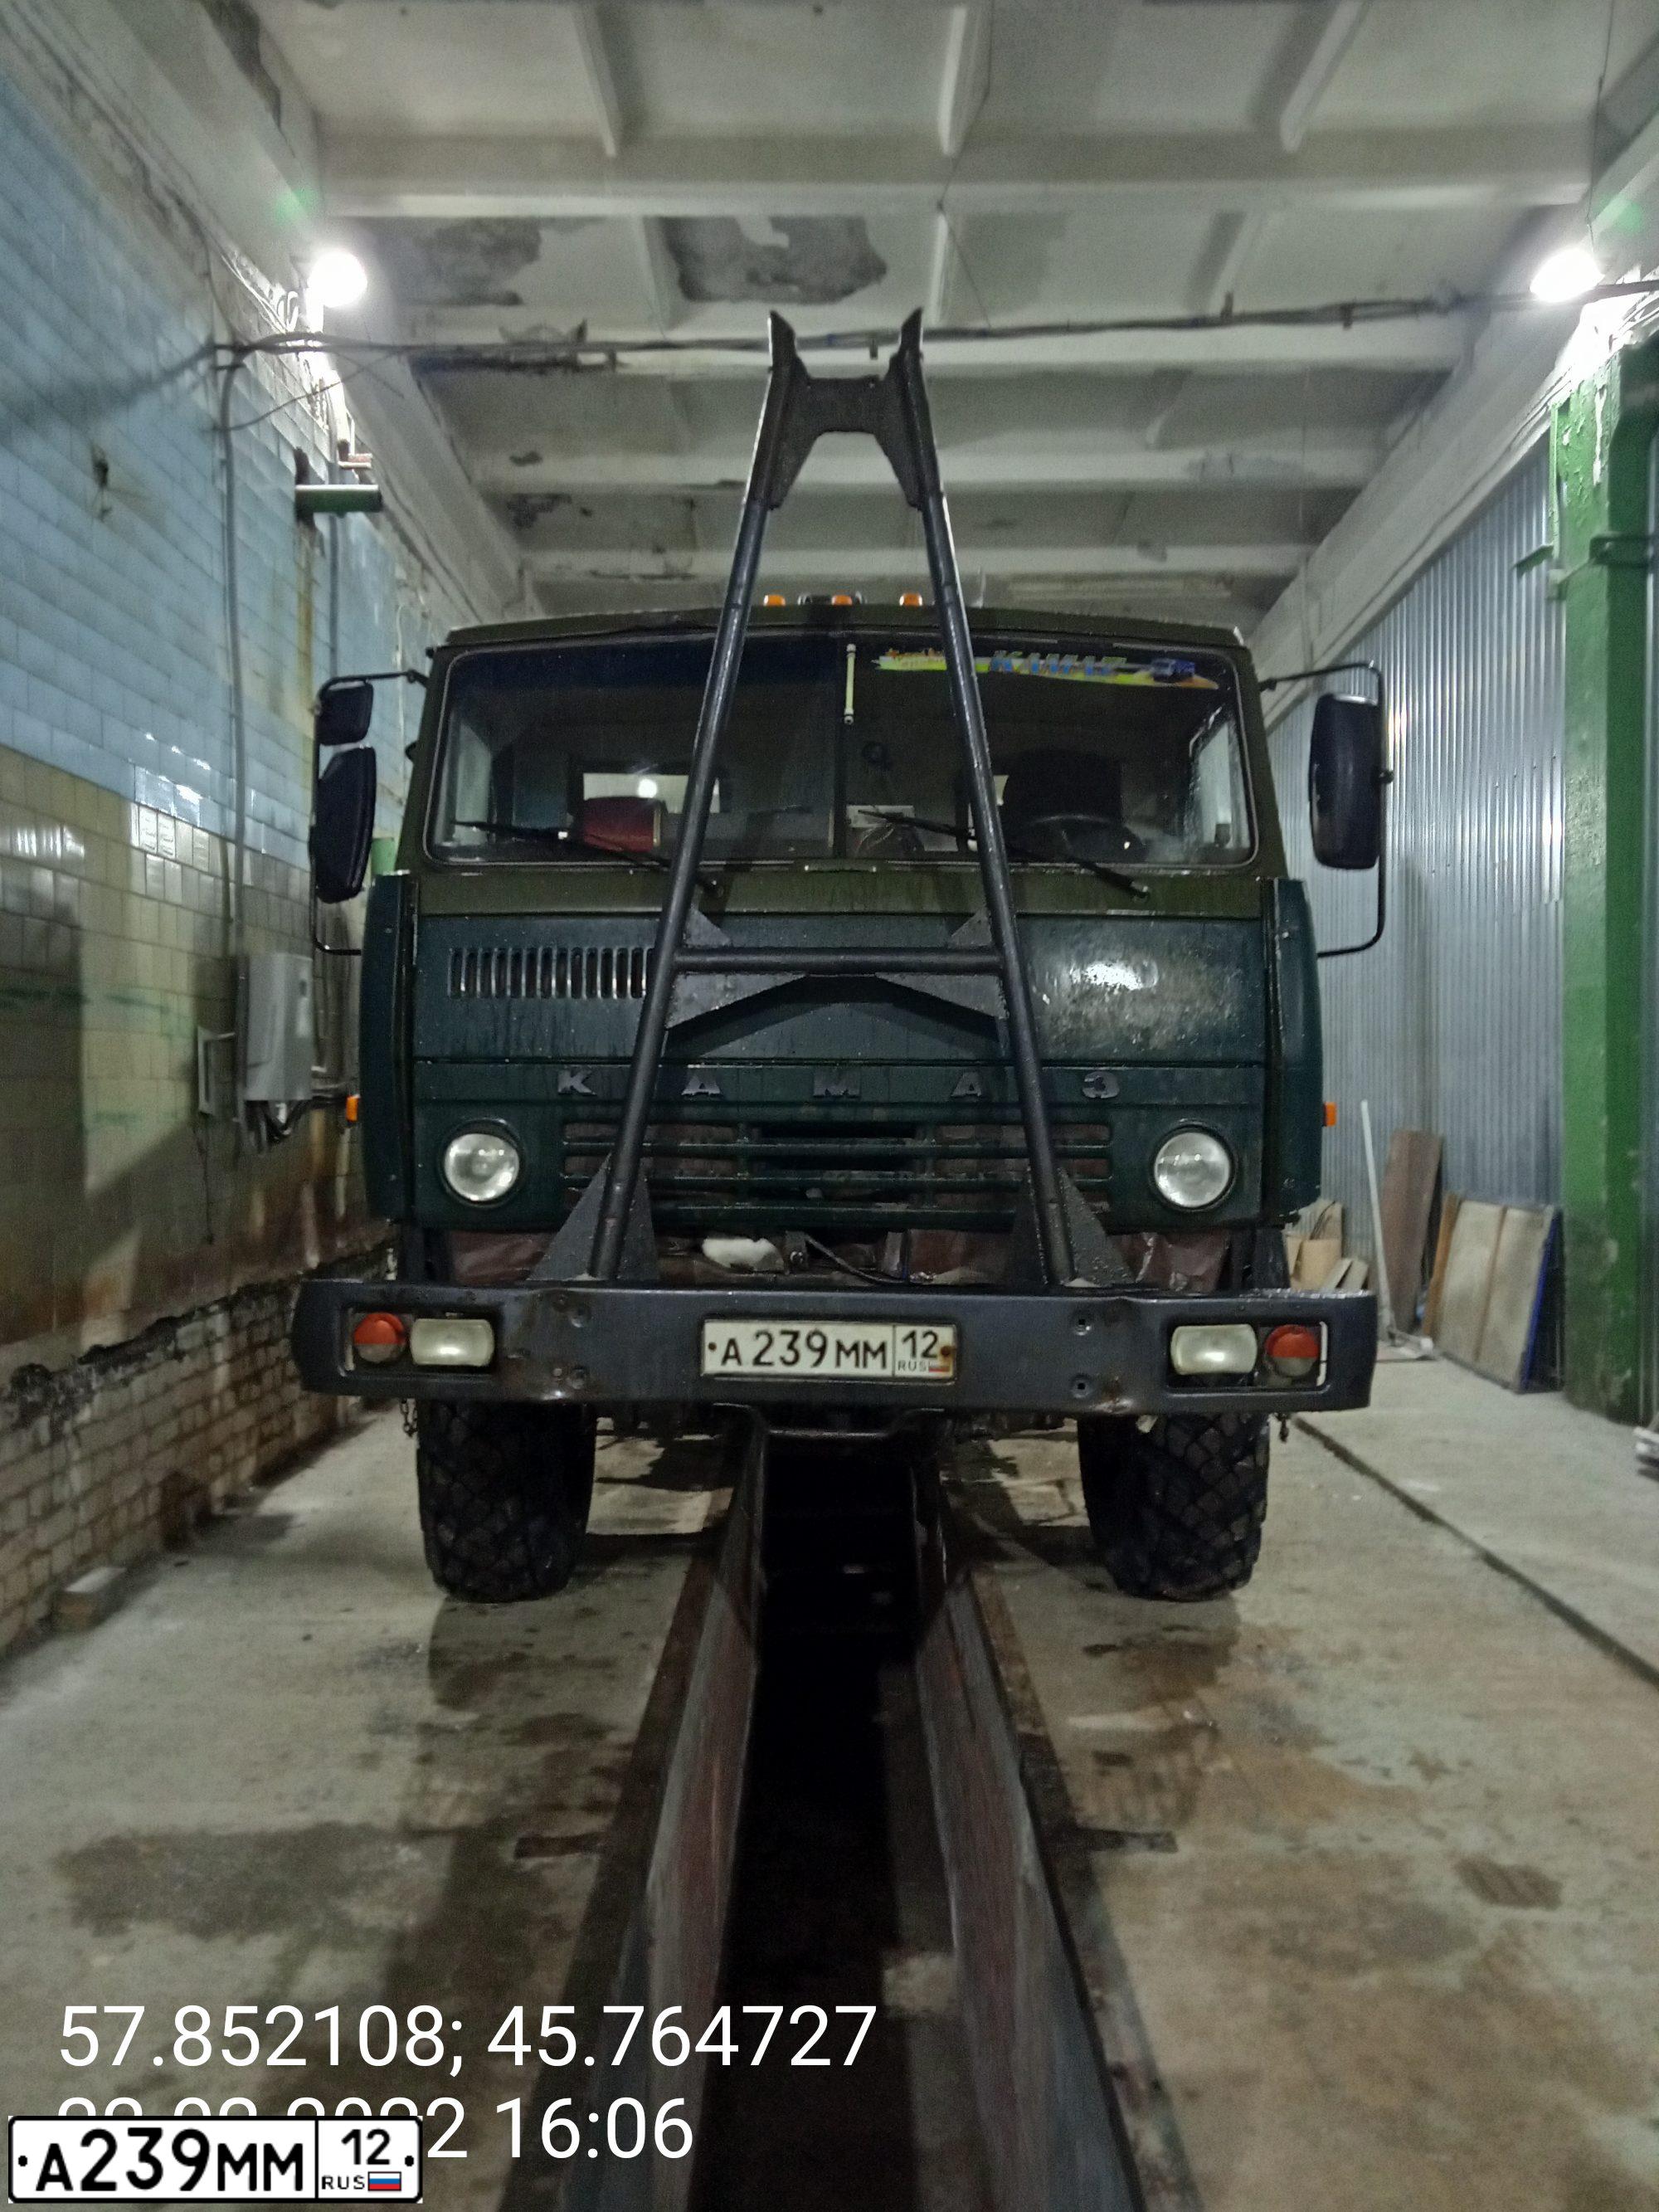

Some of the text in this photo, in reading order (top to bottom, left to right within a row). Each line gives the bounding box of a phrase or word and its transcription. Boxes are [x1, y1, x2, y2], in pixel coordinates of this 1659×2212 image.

[557, 1067, 1120, 1099] КАМАЗ
[721, 1328, 939, 1370] А239ММ 12
[897, 1359, 927, 1372] RUS
